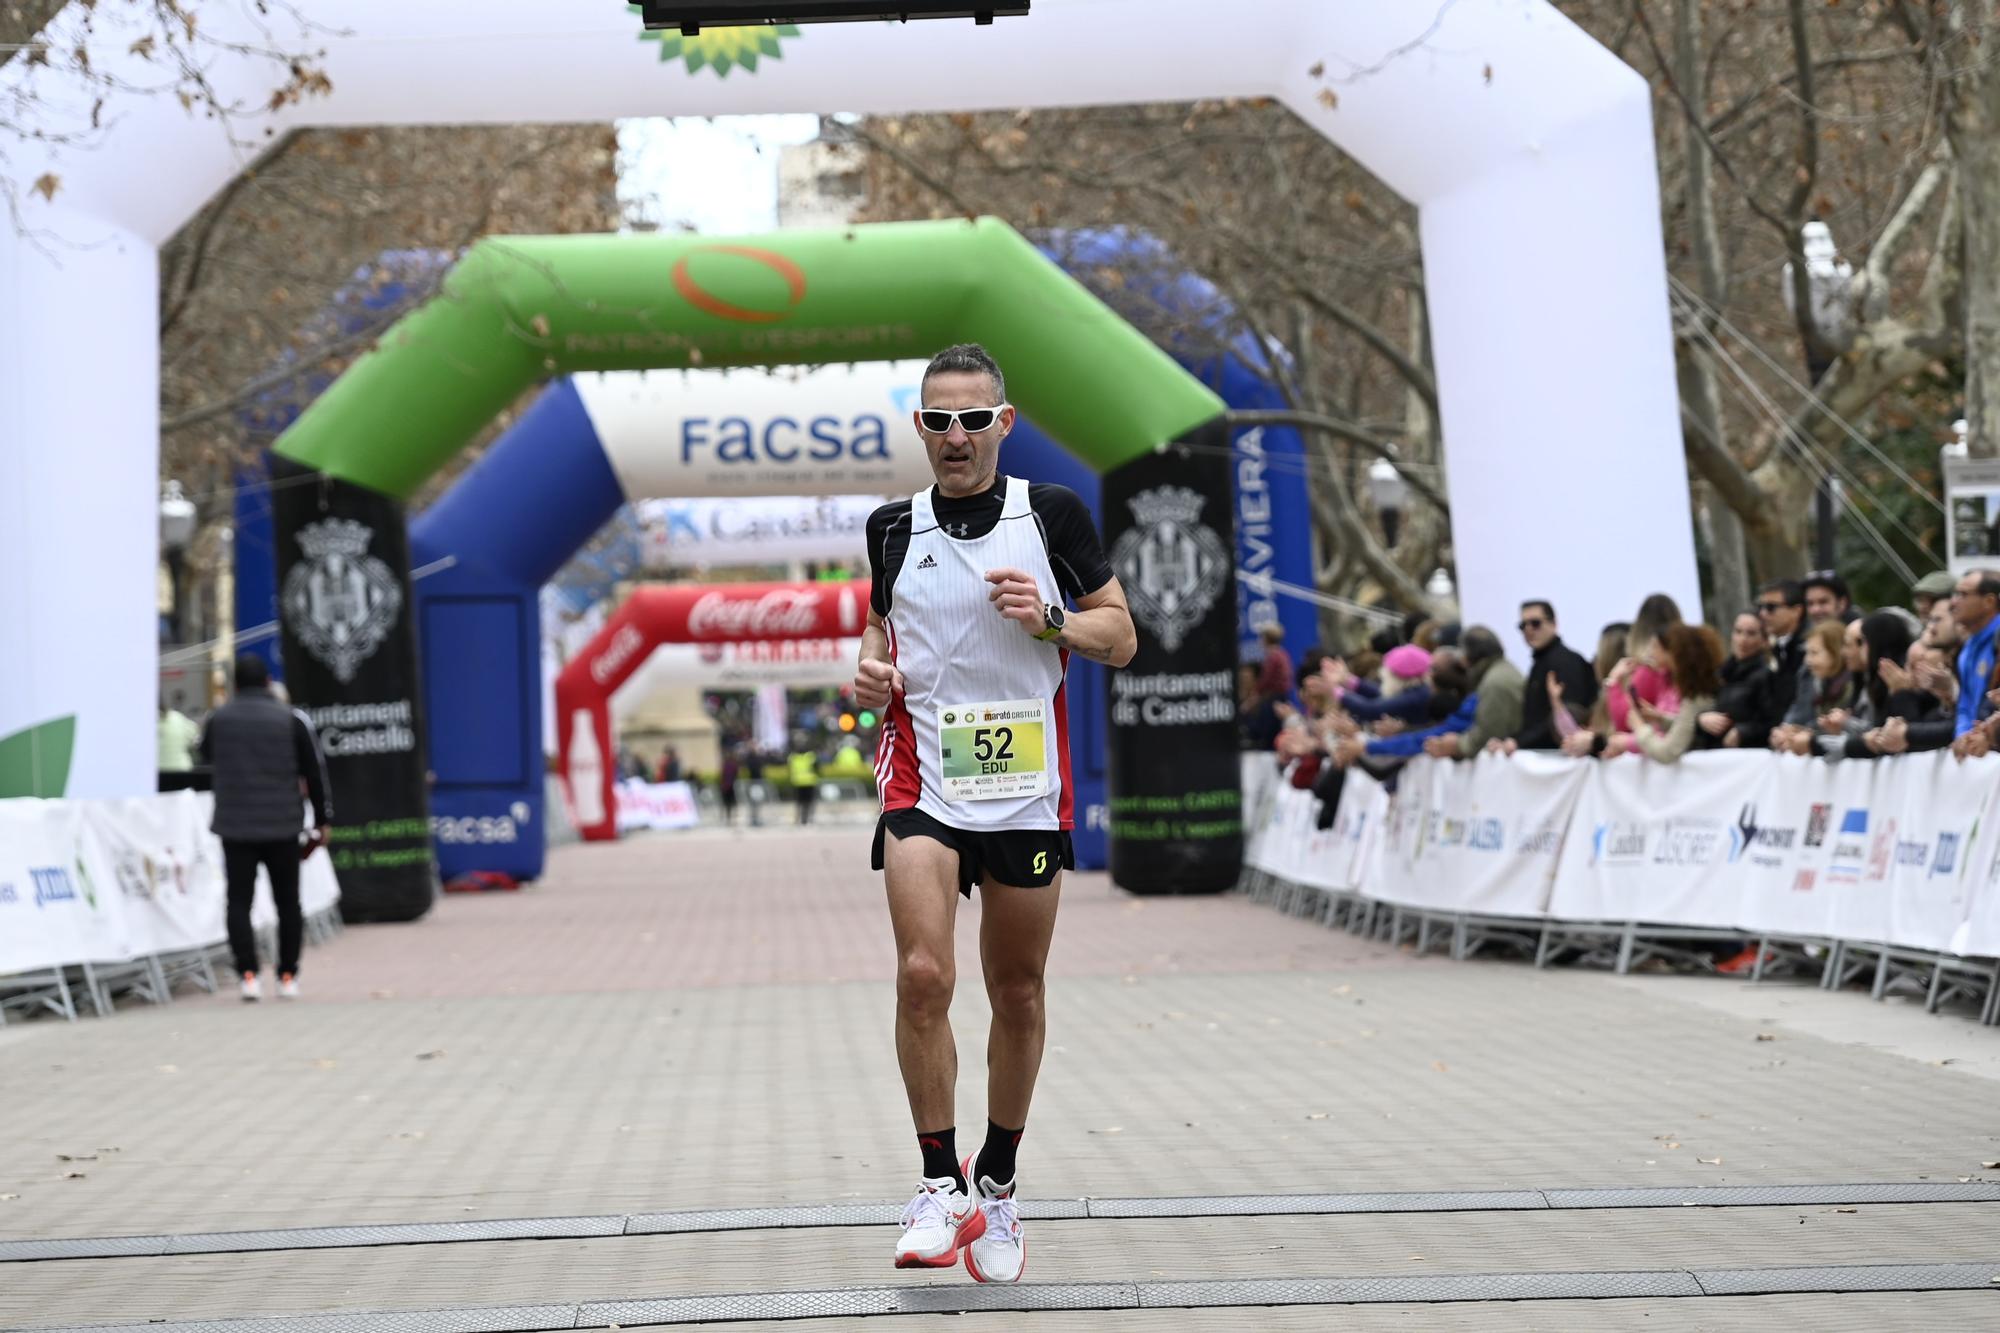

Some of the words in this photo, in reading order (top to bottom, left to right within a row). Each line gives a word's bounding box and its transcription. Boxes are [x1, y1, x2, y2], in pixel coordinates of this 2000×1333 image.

[1112, 669, 1234, 698] Ajuntament
[984, 709, 1011, 721] marató
[1011, 709, 1041, 719] CASTELLÓ
[1112, 699, 1140, 725] de
[974, 726, 1014, 761] 52
[981, 761, 1009, 775] EDU
